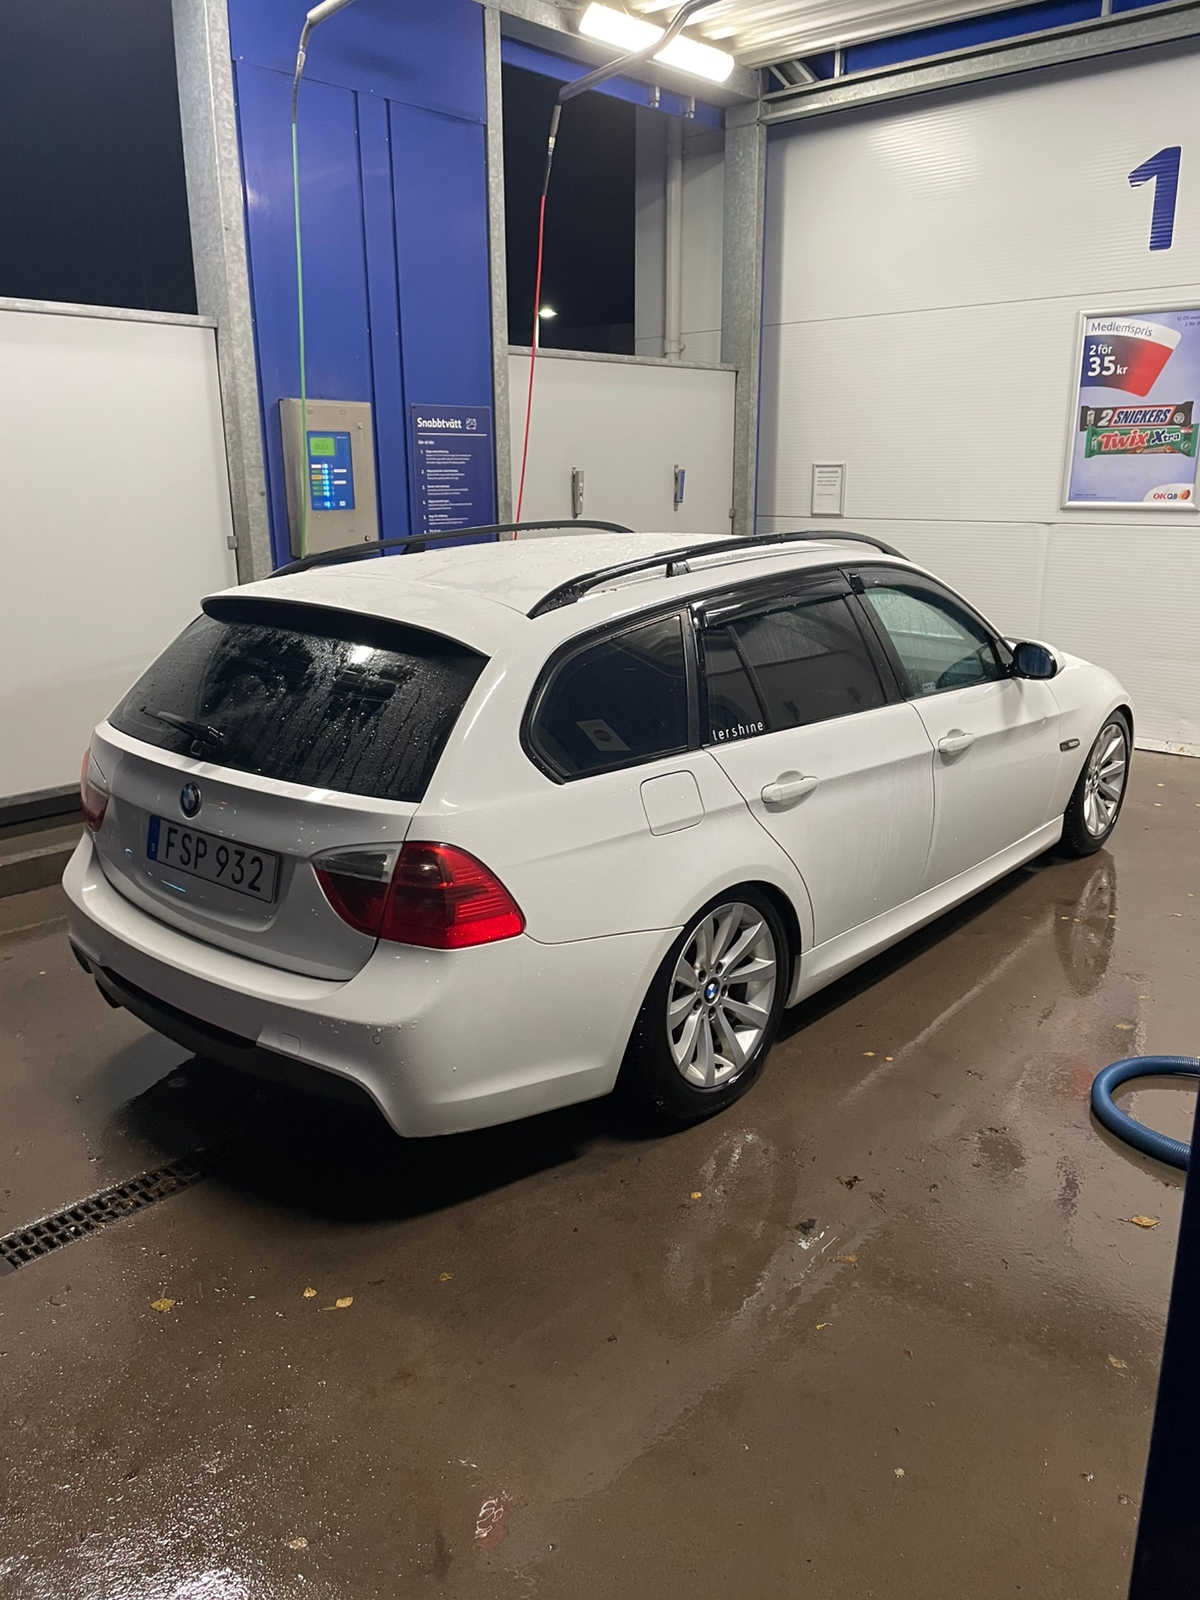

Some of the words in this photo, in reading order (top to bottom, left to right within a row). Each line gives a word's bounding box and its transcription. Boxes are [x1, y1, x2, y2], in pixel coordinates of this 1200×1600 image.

[1128, 145, 1182, 251] 1
[1091, 322, 1153, 337] Medlemspris
[1089, 345, 1097, 355] 2
[1098, 343, 1112, 355] för
[1087, 355, 1116, 377] 35
[1116, 364, 1128, 375] kr
[417, 417, 462, 429] Snabbtvätt
[1113, 408, 1171, 425] SNICKERS
[1100, 429, 1150, 451] Twix
[1150, 429, 1180, 445] Xtra
[165, 827, 208, 870] FSP
[215, 845, 264, 893] 932
